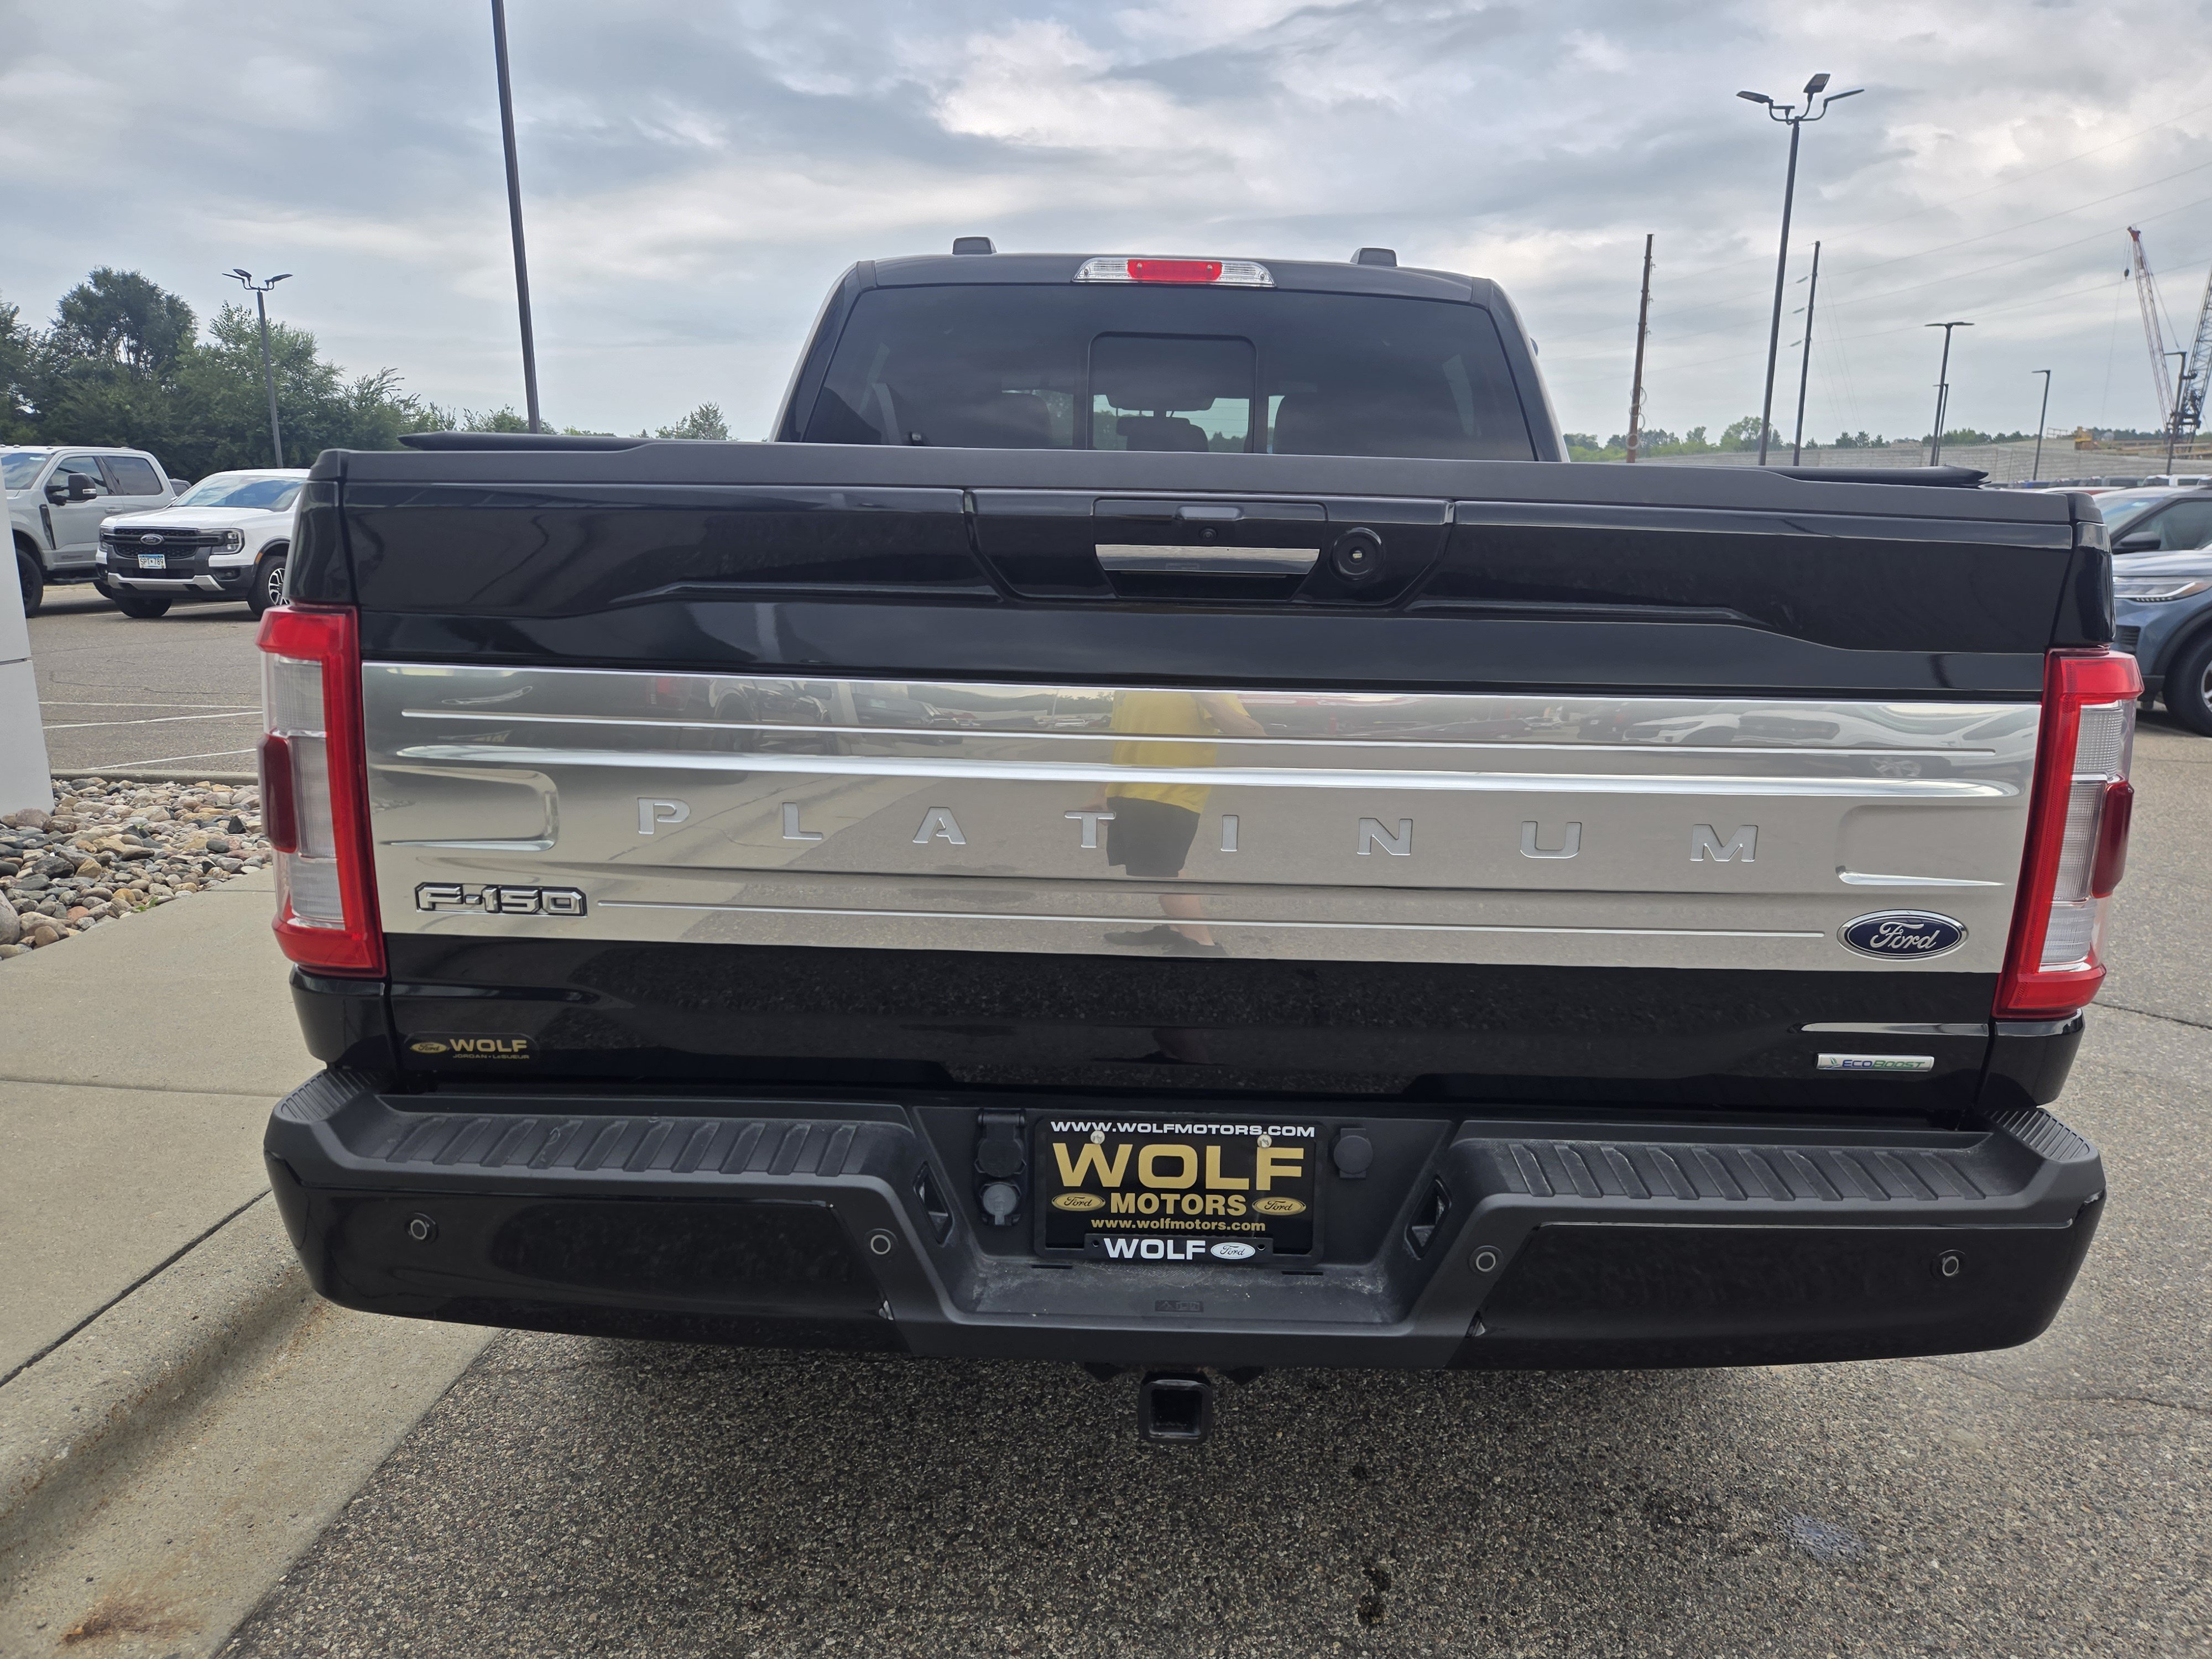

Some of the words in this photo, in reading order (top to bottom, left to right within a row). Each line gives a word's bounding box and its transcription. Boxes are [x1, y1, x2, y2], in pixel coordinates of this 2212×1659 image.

[637, 796, 1759, 862] PLATINUM
[415, 883, 587, 917] F-150
[1870, 921, 1940, 950] Ford
[450, 1039, 527, 1052] WOLF
[1051, 1121, 1315, 1138] WWW.WOLFMOTORS.COM
[1052, 1142, 1304, 1191] WOLF
[1064, 1196, 1093, 1207] Ford
[1110, 1192, 1246, 1215] MOTORS
[1264, 1199, 1293, 1211] Ford
[1091, 1218, 1265, 1232] www.wolfmotors.com
[1103, 1238, 1206, 1260] WOLF
[1220, 1245, 1245, 1256] Ford
